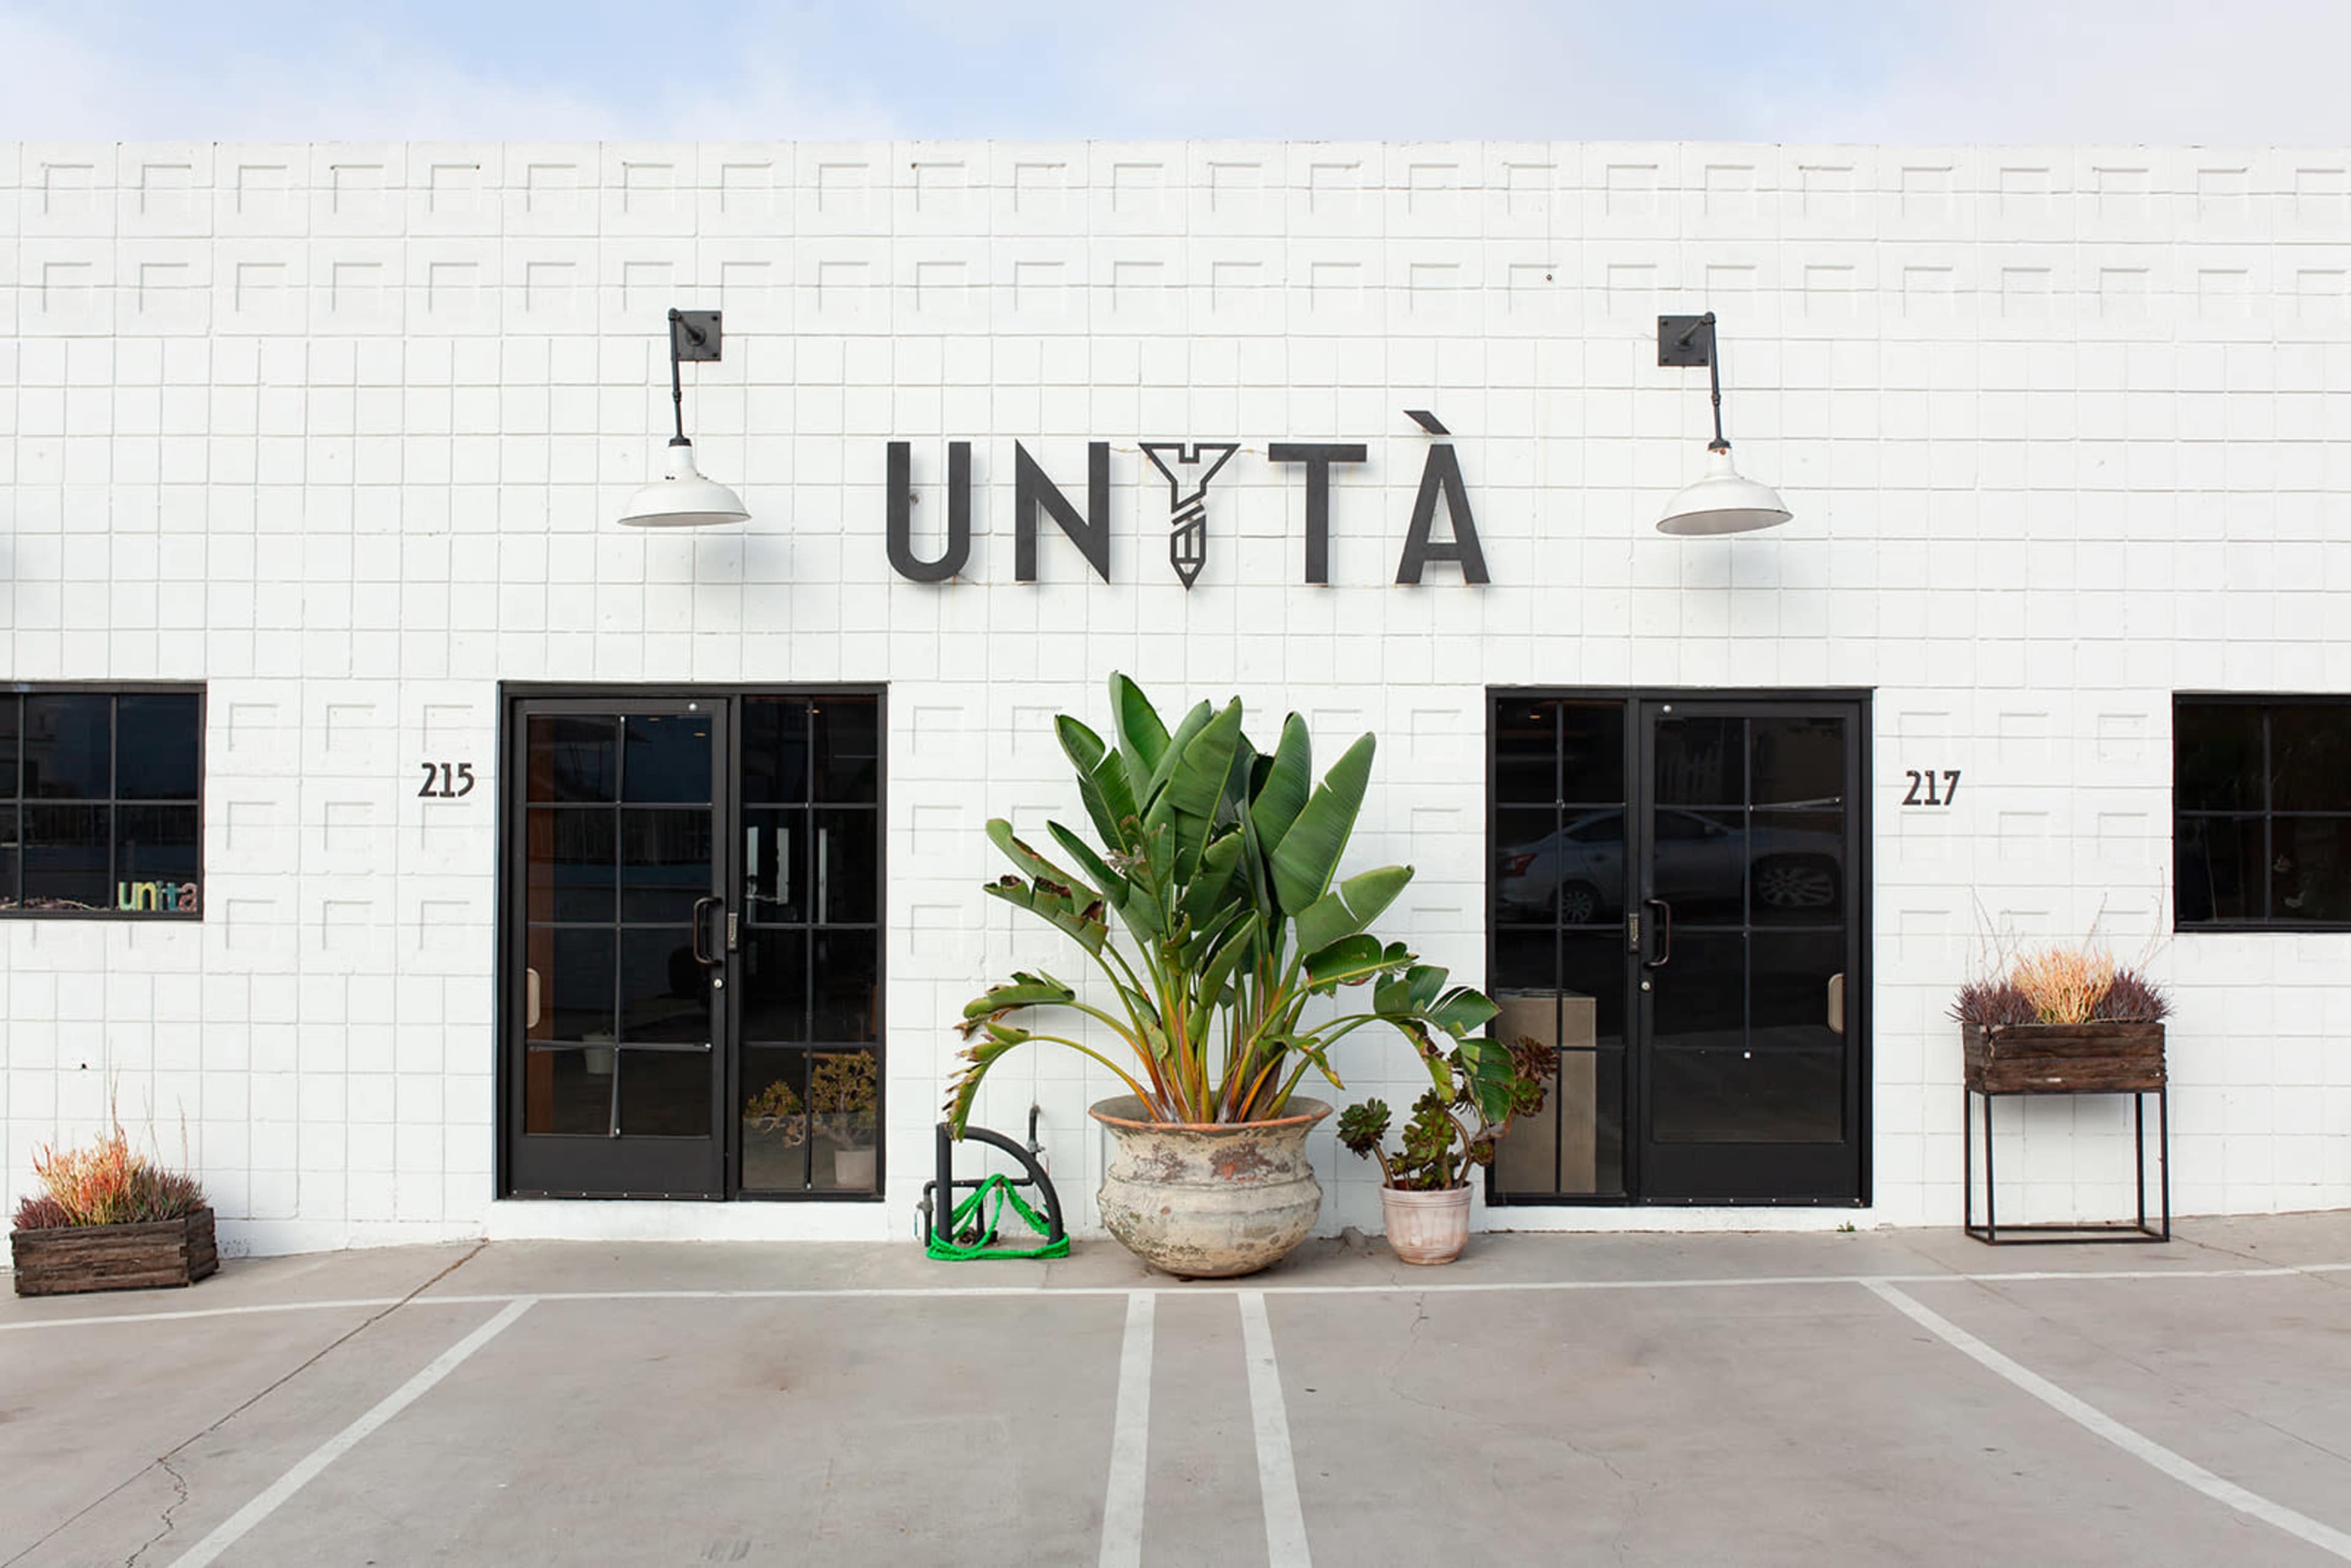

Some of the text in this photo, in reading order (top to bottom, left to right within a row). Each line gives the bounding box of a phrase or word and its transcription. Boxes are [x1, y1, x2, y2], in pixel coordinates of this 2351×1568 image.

[418, 763, 474, 797] 215
[1902, 770, 1961, 805] 217
[118, 881, 197, 911] unita
